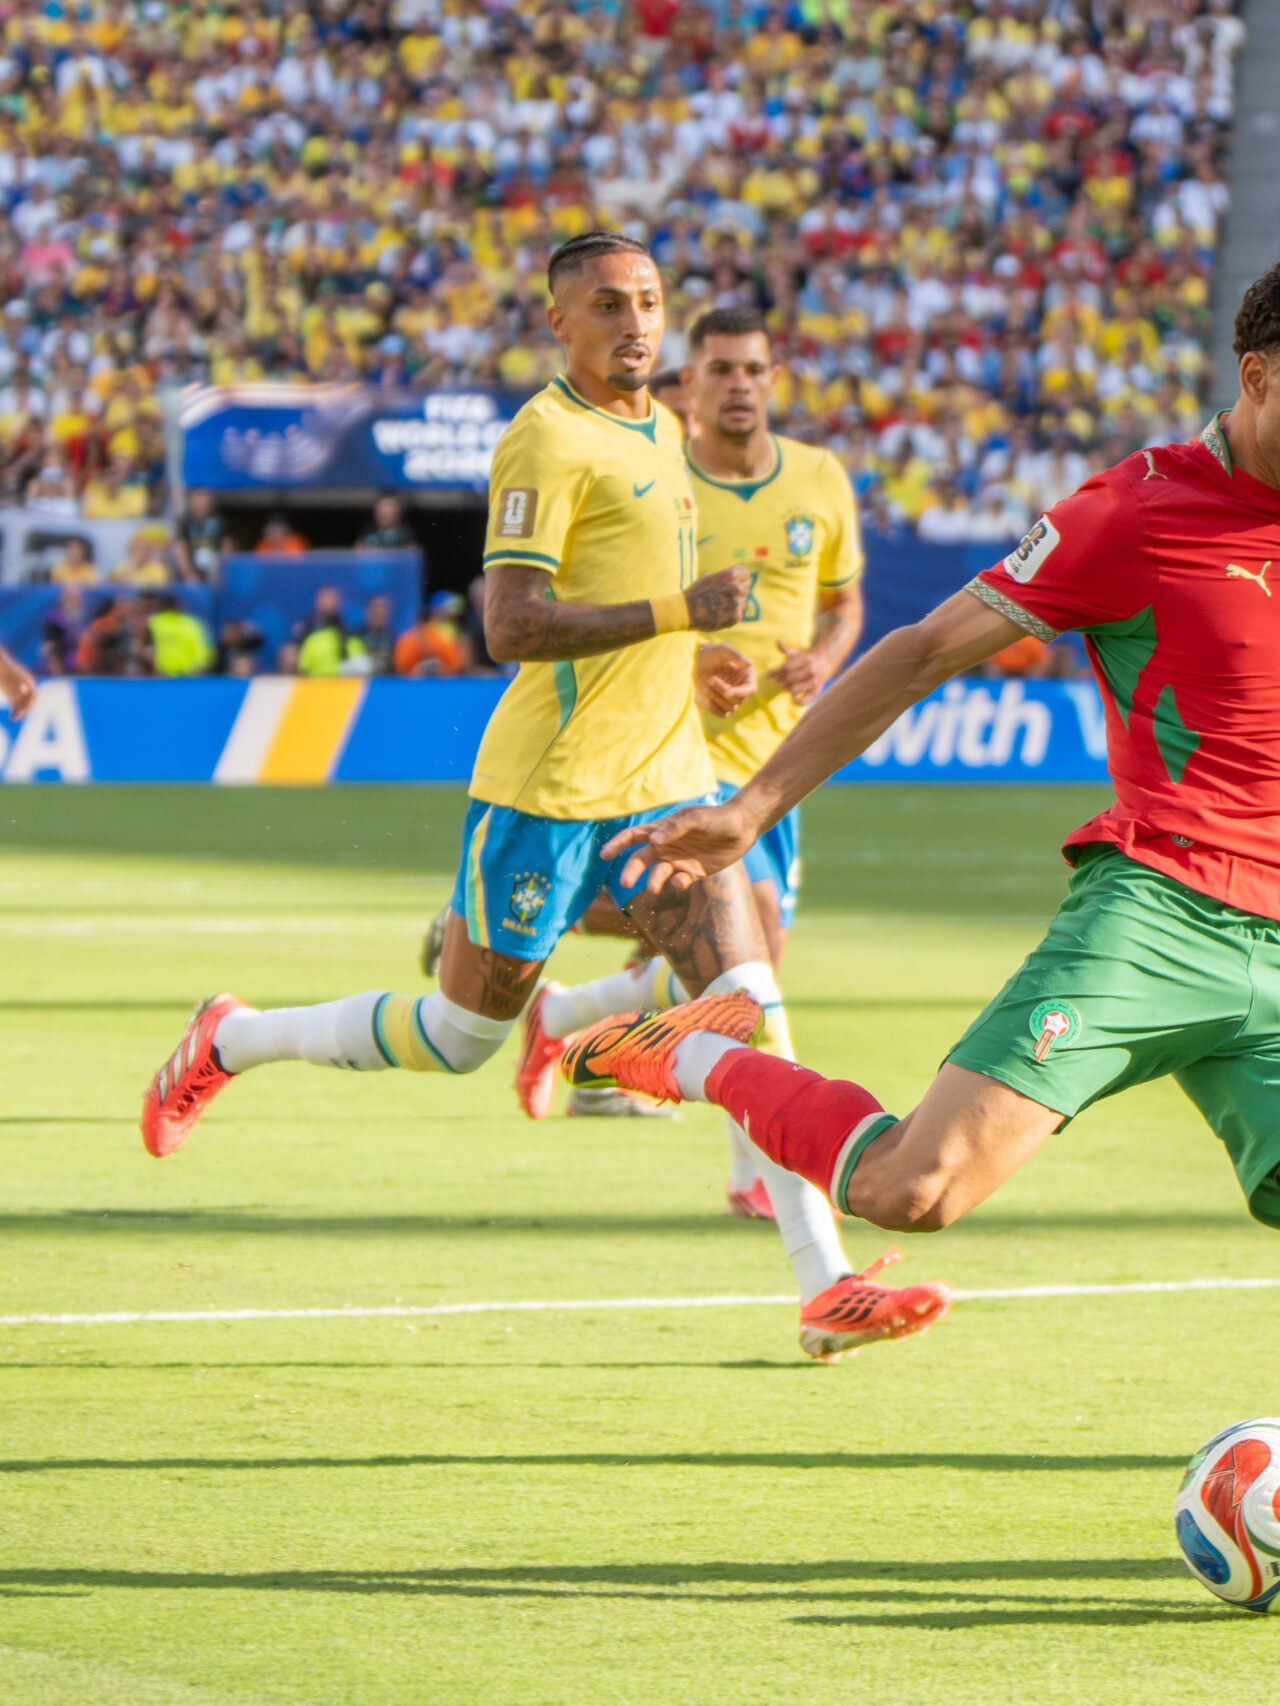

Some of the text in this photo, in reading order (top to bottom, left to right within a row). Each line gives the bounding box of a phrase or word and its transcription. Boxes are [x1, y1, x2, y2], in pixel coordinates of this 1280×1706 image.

[424, 394, 496, 423] FIFA
[373, 419, 481, 454] WORLD
[678, 527, 694, 591] 11
[861, 681, 1051, 767] with
